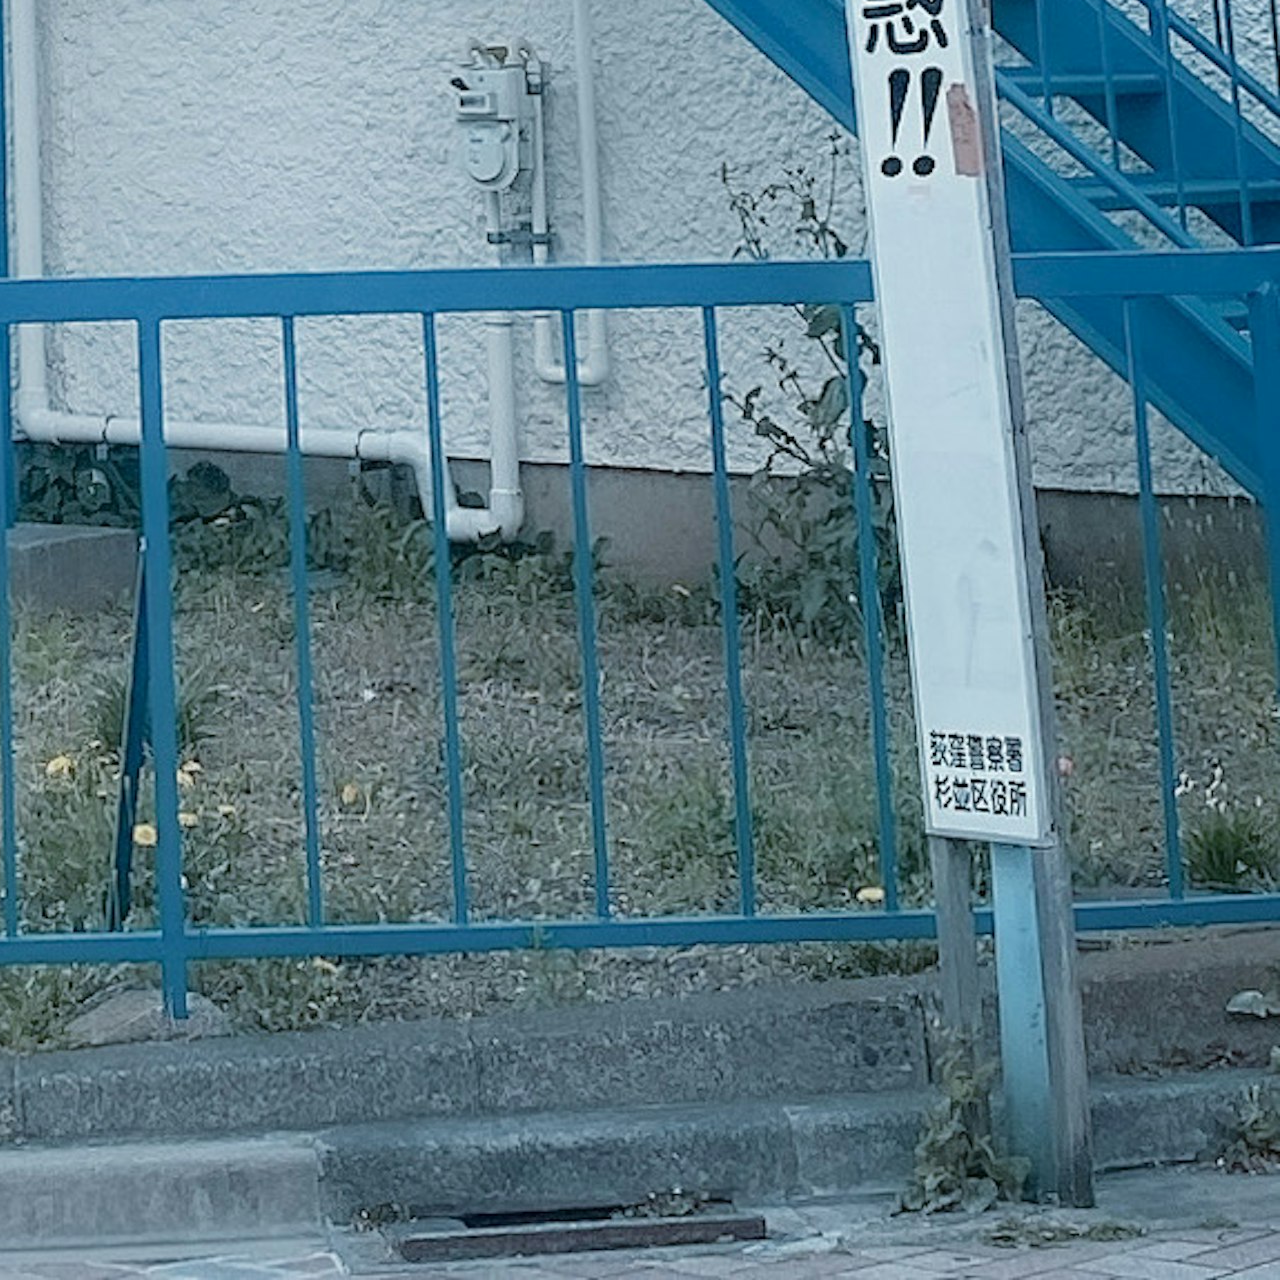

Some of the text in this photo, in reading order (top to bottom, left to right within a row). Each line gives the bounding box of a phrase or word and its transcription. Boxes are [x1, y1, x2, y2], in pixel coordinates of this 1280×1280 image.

[930, 730, 1023, 772] 荻窪警察署
[934, 774, 1028, 817] 杉並区役所
